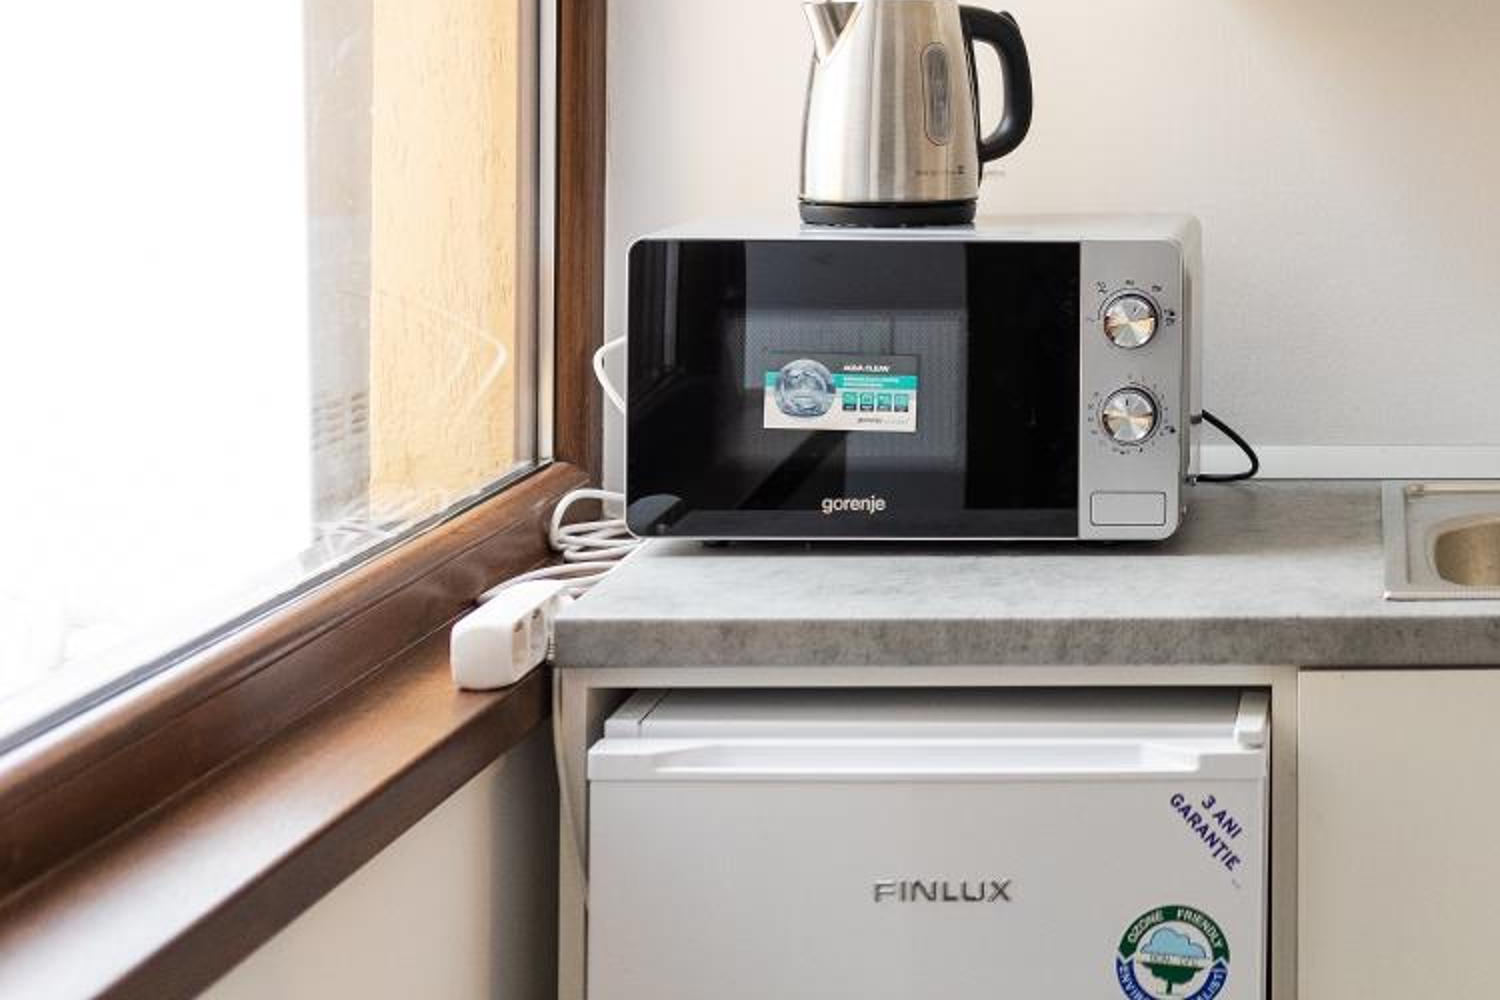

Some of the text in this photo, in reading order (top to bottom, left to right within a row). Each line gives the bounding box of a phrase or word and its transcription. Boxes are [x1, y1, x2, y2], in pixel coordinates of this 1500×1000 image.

[821, 495, 886, 515] gorenje
[1201, 794, 1243, 839] 3 ANI
[873, 879, 1011, 903] FINLUX
[1127, 907, 1224, 948] OZONE FRIENDLY
